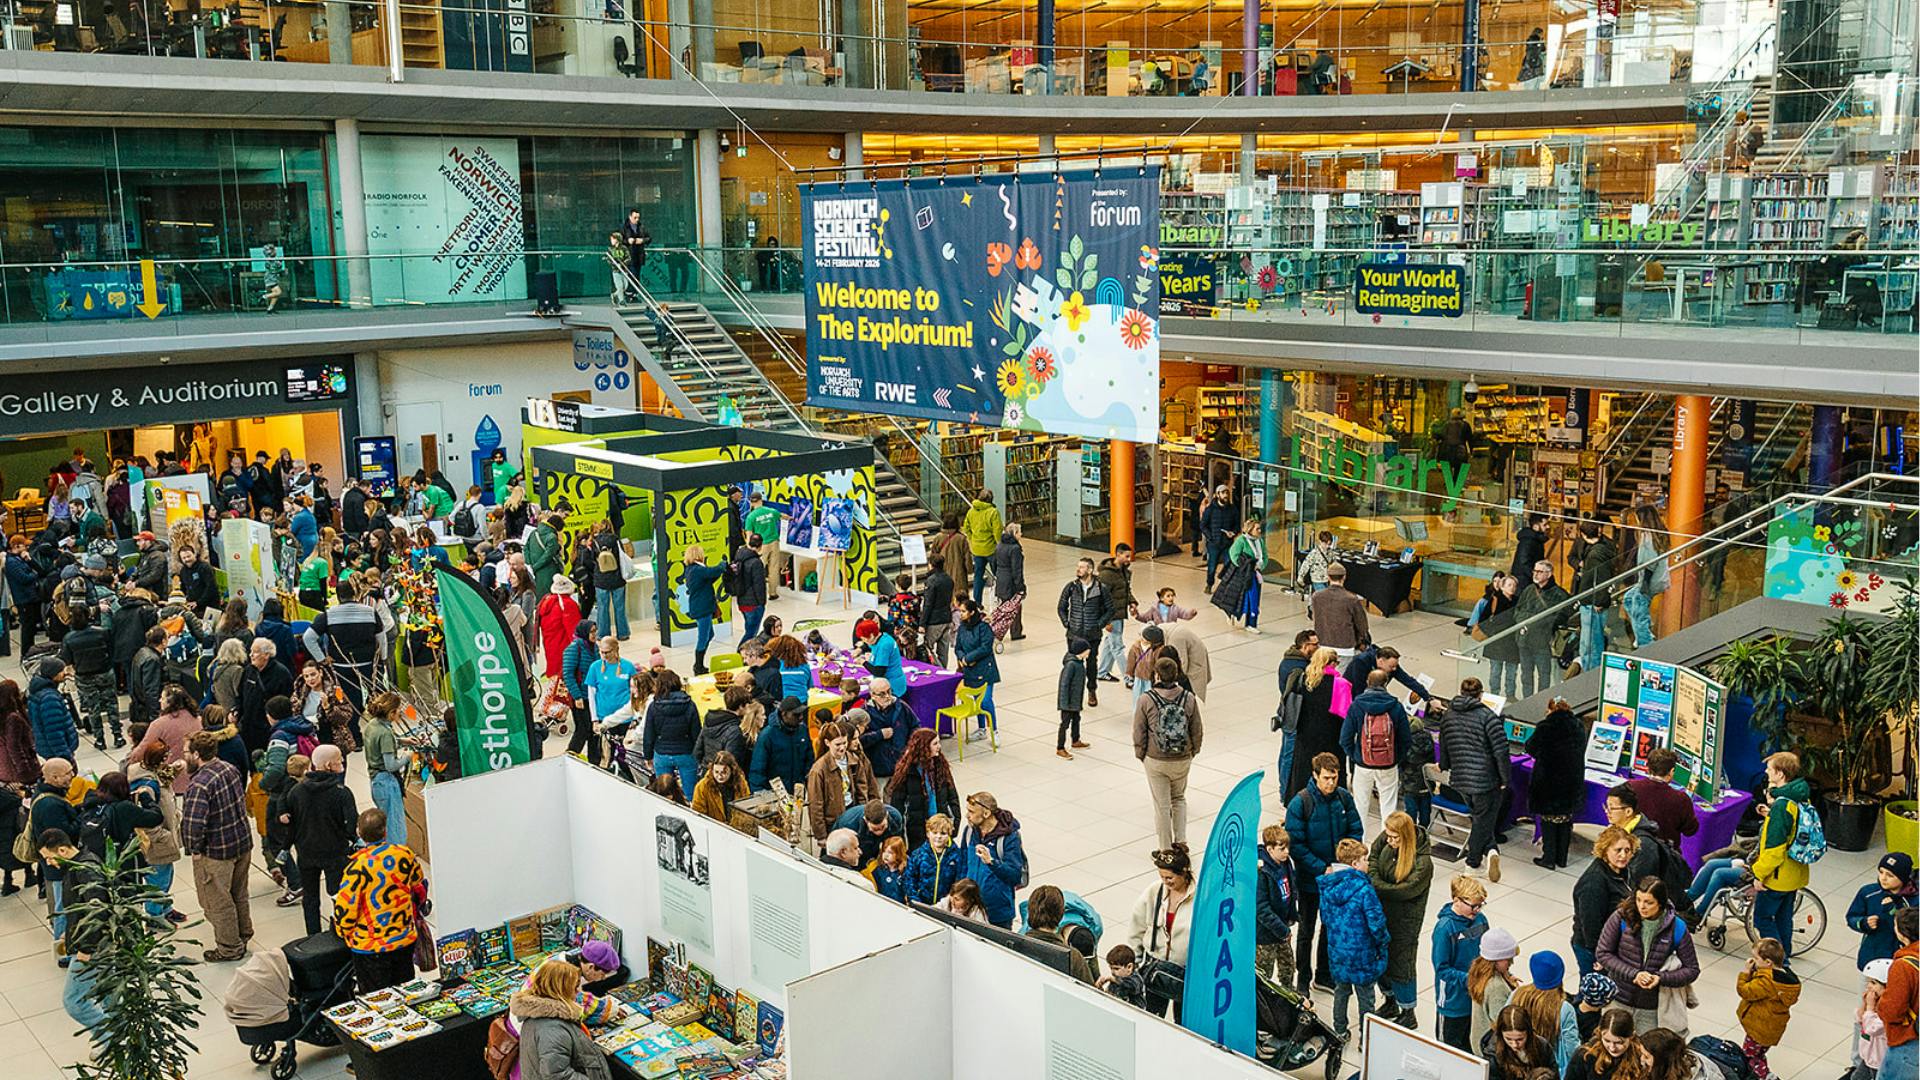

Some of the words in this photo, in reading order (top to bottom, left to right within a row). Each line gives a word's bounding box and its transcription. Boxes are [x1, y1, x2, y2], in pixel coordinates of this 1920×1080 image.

[511, 0, 526, 51] BC
[448, 147, 518, 216] NORWICH
[471, 156, 520, 204] ATTLEBOROUG
[474, 146, 521, 194] SWAFFHA
[438, 164, 492, 216] FAKENHAM
[1092, 188, 1118, 197] Presented
[814, 199, 878, 219] NORWICH
[1090, 200, 1141, 227] forum
[432, 208, 479, 264] THETFORD
[814, 218, 870, 238] SCIENCE
[1583, 217, 1701, 247] Library
[815, 237, 880, 257] FESTIVAL
[832, 259, 864, 268] FEBRUARY
[865, 258, 880, 267] 2026
[1161, 275, 1212, 296] Years
[1361, 268, 1401, 287] Your
[1403, 269, 1460, 291] World,
[816, 281, 912, 311] Welcome
[915, 286, 940, 311] to
[1359, 288, 1460, 314] Reimagined
[586, 336, 613, 351] Toilets
[817, 313, 854, 341] The
[857, 316, 973, 351] Explorium!
[820, 366, 851, 377] NORWICH
[825, 376, 863, 389] UNIVERSITY
[0, 391, 100, 414] Gallery
[110, 388, 130, 407] &
[139, 378, 279, 405] Auditorium
[469, 383, 502, 397] forum
[818, 384, 828, 395] OF
[829, 385, 841, 396] THE
[841, 387, 860, 398] ARTS
[875, 382, 917, 403] RWE
[1674, 405, 1688, 450] Library
[1291, 432, 1471, 513] Library
